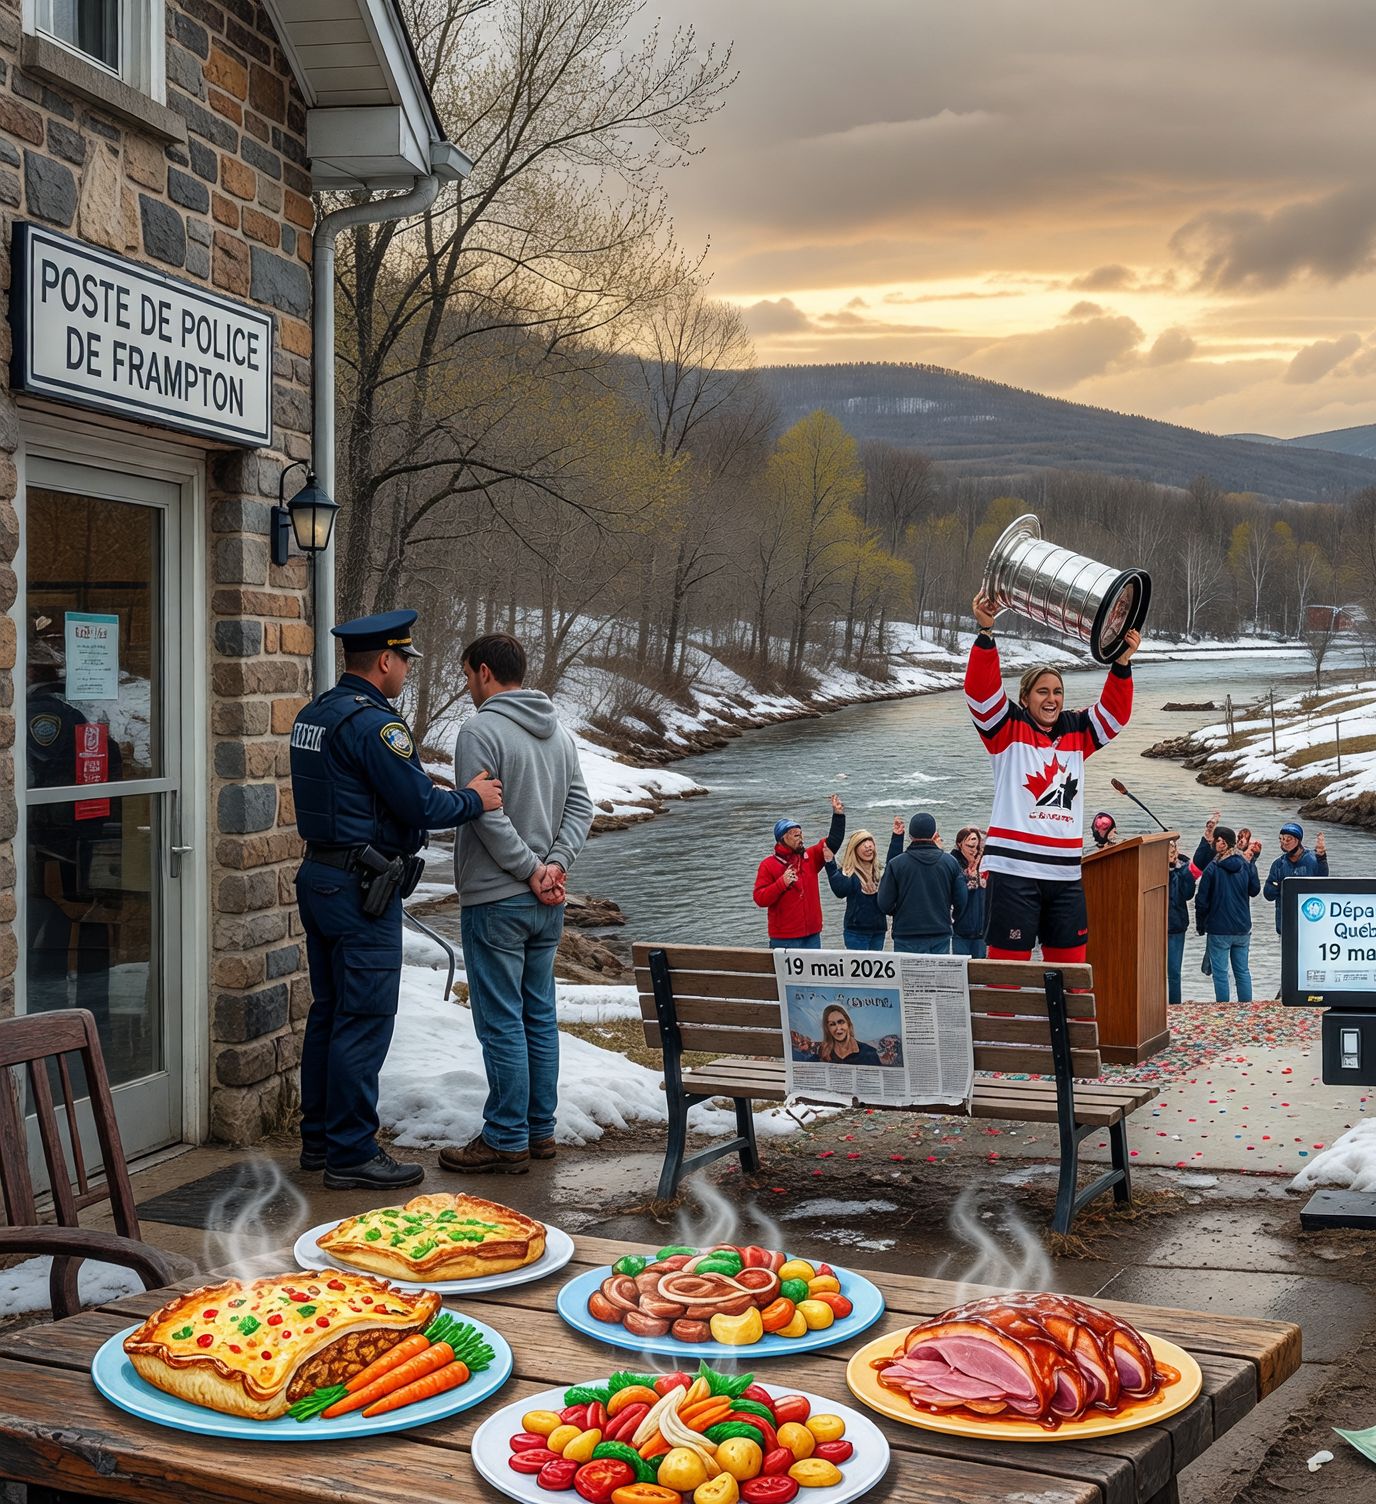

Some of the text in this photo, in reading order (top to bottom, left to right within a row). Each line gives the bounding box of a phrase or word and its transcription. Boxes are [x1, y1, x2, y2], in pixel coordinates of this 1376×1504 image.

[41, 258, 260, 371] POSTE DE POLICE
[66, 325, 244, 417] DE FRAMPTON
[784, 957, 896, 979] 19 mai 2026
[1318, 943, 1341, 961] 19
